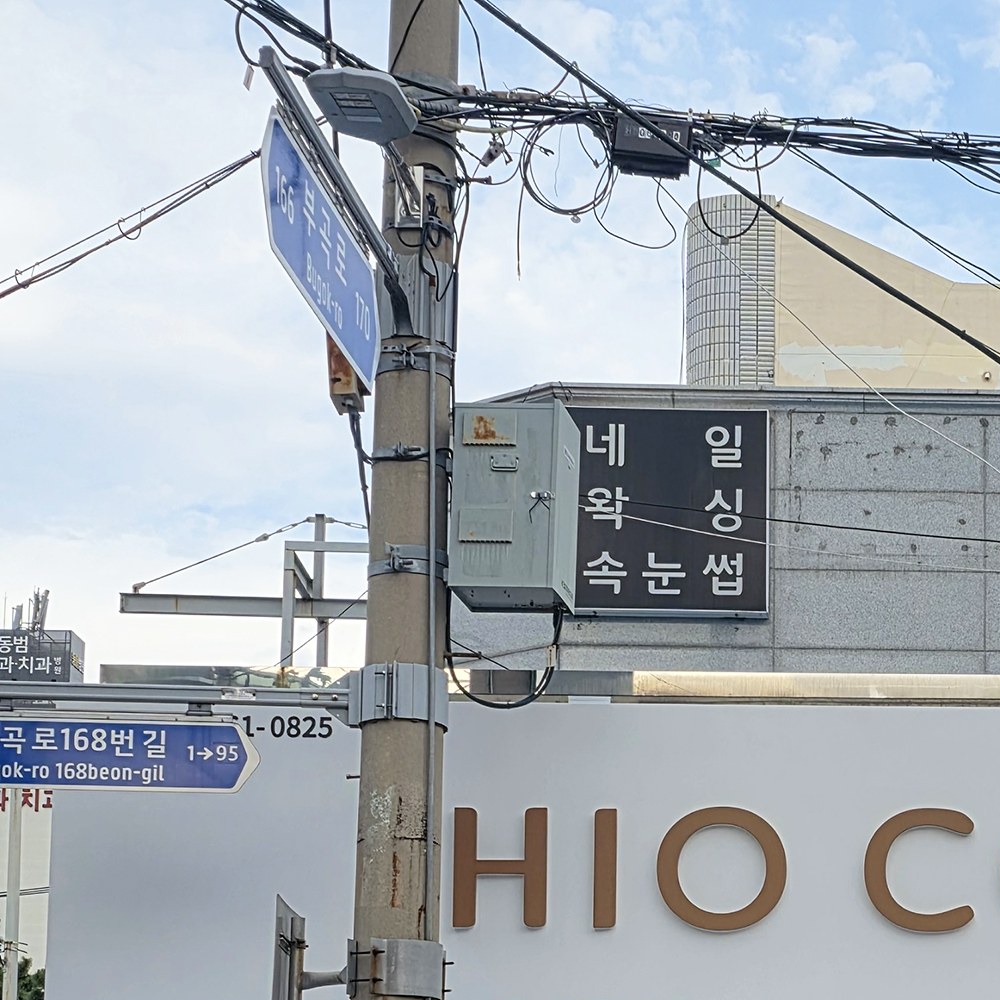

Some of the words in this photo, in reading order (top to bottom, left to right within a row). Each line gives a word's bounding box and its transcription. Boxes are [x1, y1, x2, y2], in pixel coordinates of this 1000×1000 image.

[275, 165, 295, 225] 166
[302, 179, 347, 287] 부곡로
[306, 252, 343, 330] Bugok-ro
[355, 291, 371, 341] 170
[55, 762, 166, 785] 168beon-gil
[452, 805, 788, 933] HIO
